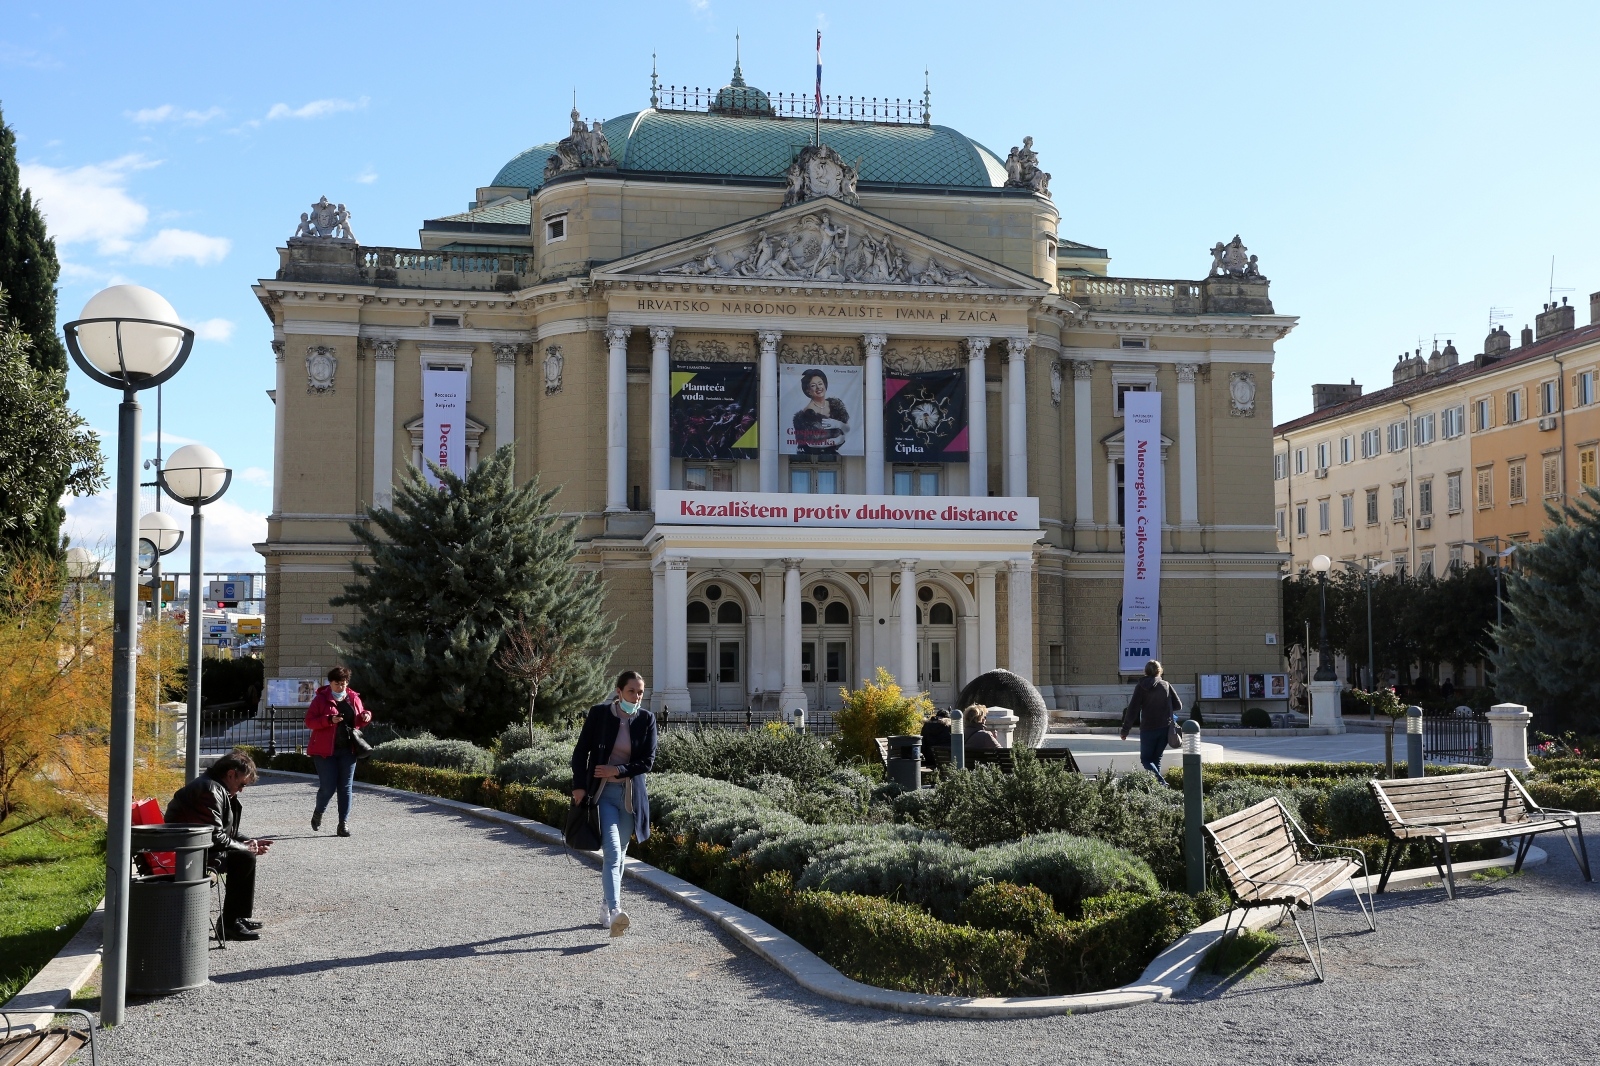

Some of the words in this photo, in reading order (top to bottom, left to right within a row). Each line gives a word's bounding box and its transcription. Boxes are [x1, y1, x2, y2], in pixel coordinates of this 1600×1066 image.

[637, 299, 710, 313] HRVATSKO
[722, 302, 797, 315] NARODNO
[808, 304, 884, 319] KAZALIŠTE
[896, 308, 935, 320] IVANA
[958, 309, 998, 322] ZAJCA
[682, 383, 726, 392] Plamteća
[682, 392, 704, 401] voda
[894, 441, 925, 455] Čipka
[1135, 439, 1149, 513] Musorgski,
[680, 499, 788, 518] Kazalištem
[792, 503, 851, 523] protiv
[855, 504, 938, 521] duhovne
[940, 505, 1019, 522] distance
[1135, 516, 1150, 580] Čajkovski
